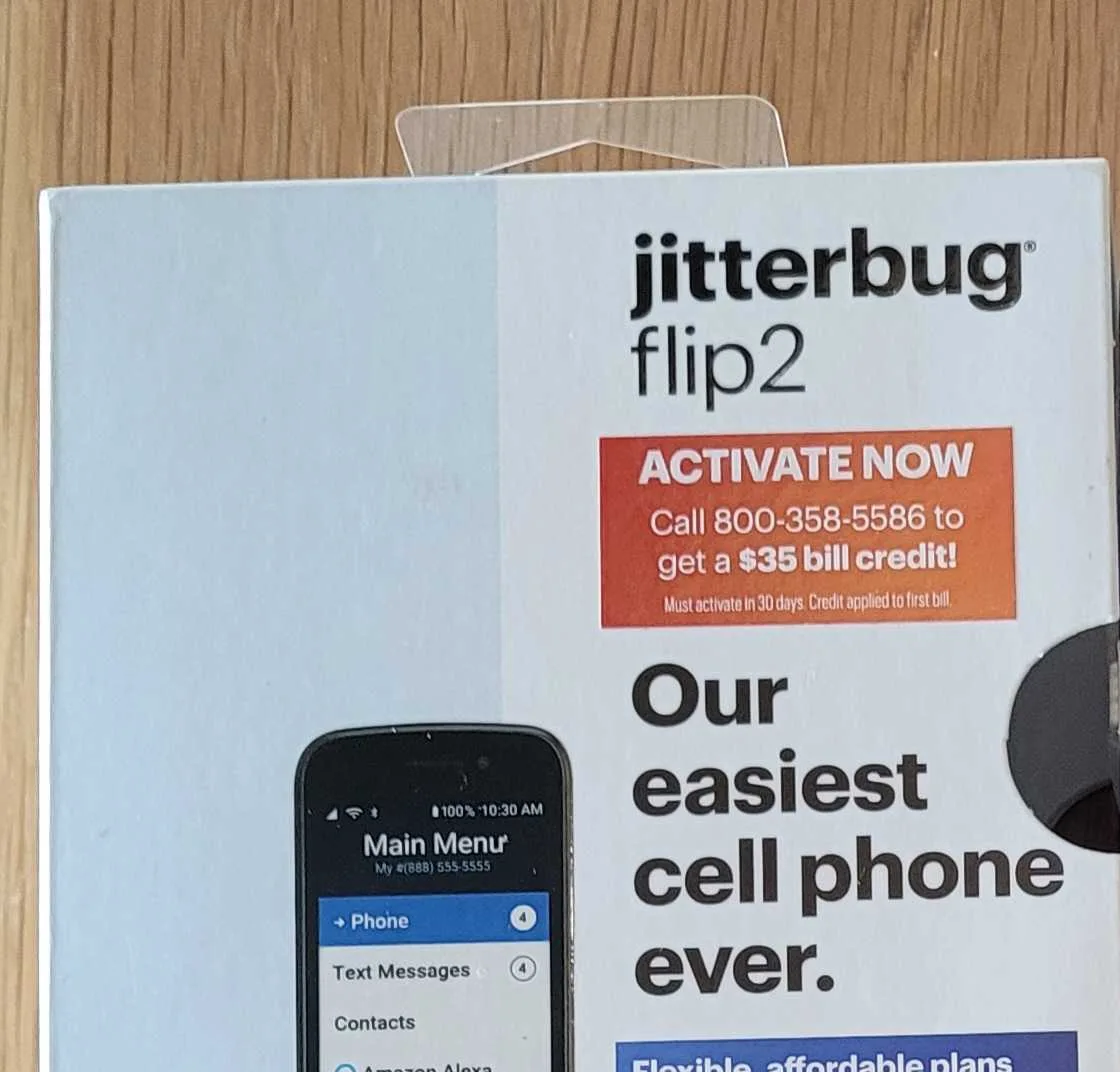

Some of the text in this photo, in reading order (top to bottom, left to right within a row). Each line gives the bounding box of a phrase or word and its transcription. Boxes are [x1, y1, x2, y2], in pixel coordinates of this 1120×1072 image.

[630, 323, 806, 412] flip2
[638, 443, 974, 485] ACTIVATE NOW
[650, 505, 964, 536] Call 800-358-5586 to
[658, 543, 957, 581] get a $35 bill credit!
[664, 596, 693, 613] Must
[696, 597, 742, 612] activate
[745, 597, 755, 611] in
[758, 596, 773, 611] 30
[809, 594, 844, 610] Credit
[847, 593, 889, 611] applied
[892, 594, 904, 608] to
[907, 591, 930, 607] first
[932, 590, 951, 608] bill.
[632, 663, 788, 727] Our
[632, 748, 928, 816] easiest
[442, 803, 543, 818] 100% 10:30 AM
[364, 832, 504, 856] Main Menu
[376, 864, 393, 876] My
[437, 860, 491, 873] 555-5555
[634, 835, 1064, 918] cell phone
[351, 913, 527, 930] Phone 4
[333, 963, 527, 981] Text Messages 4
[635, 943, 835, 995] ever.
[335, 1015, 415, 1032] Contacts
